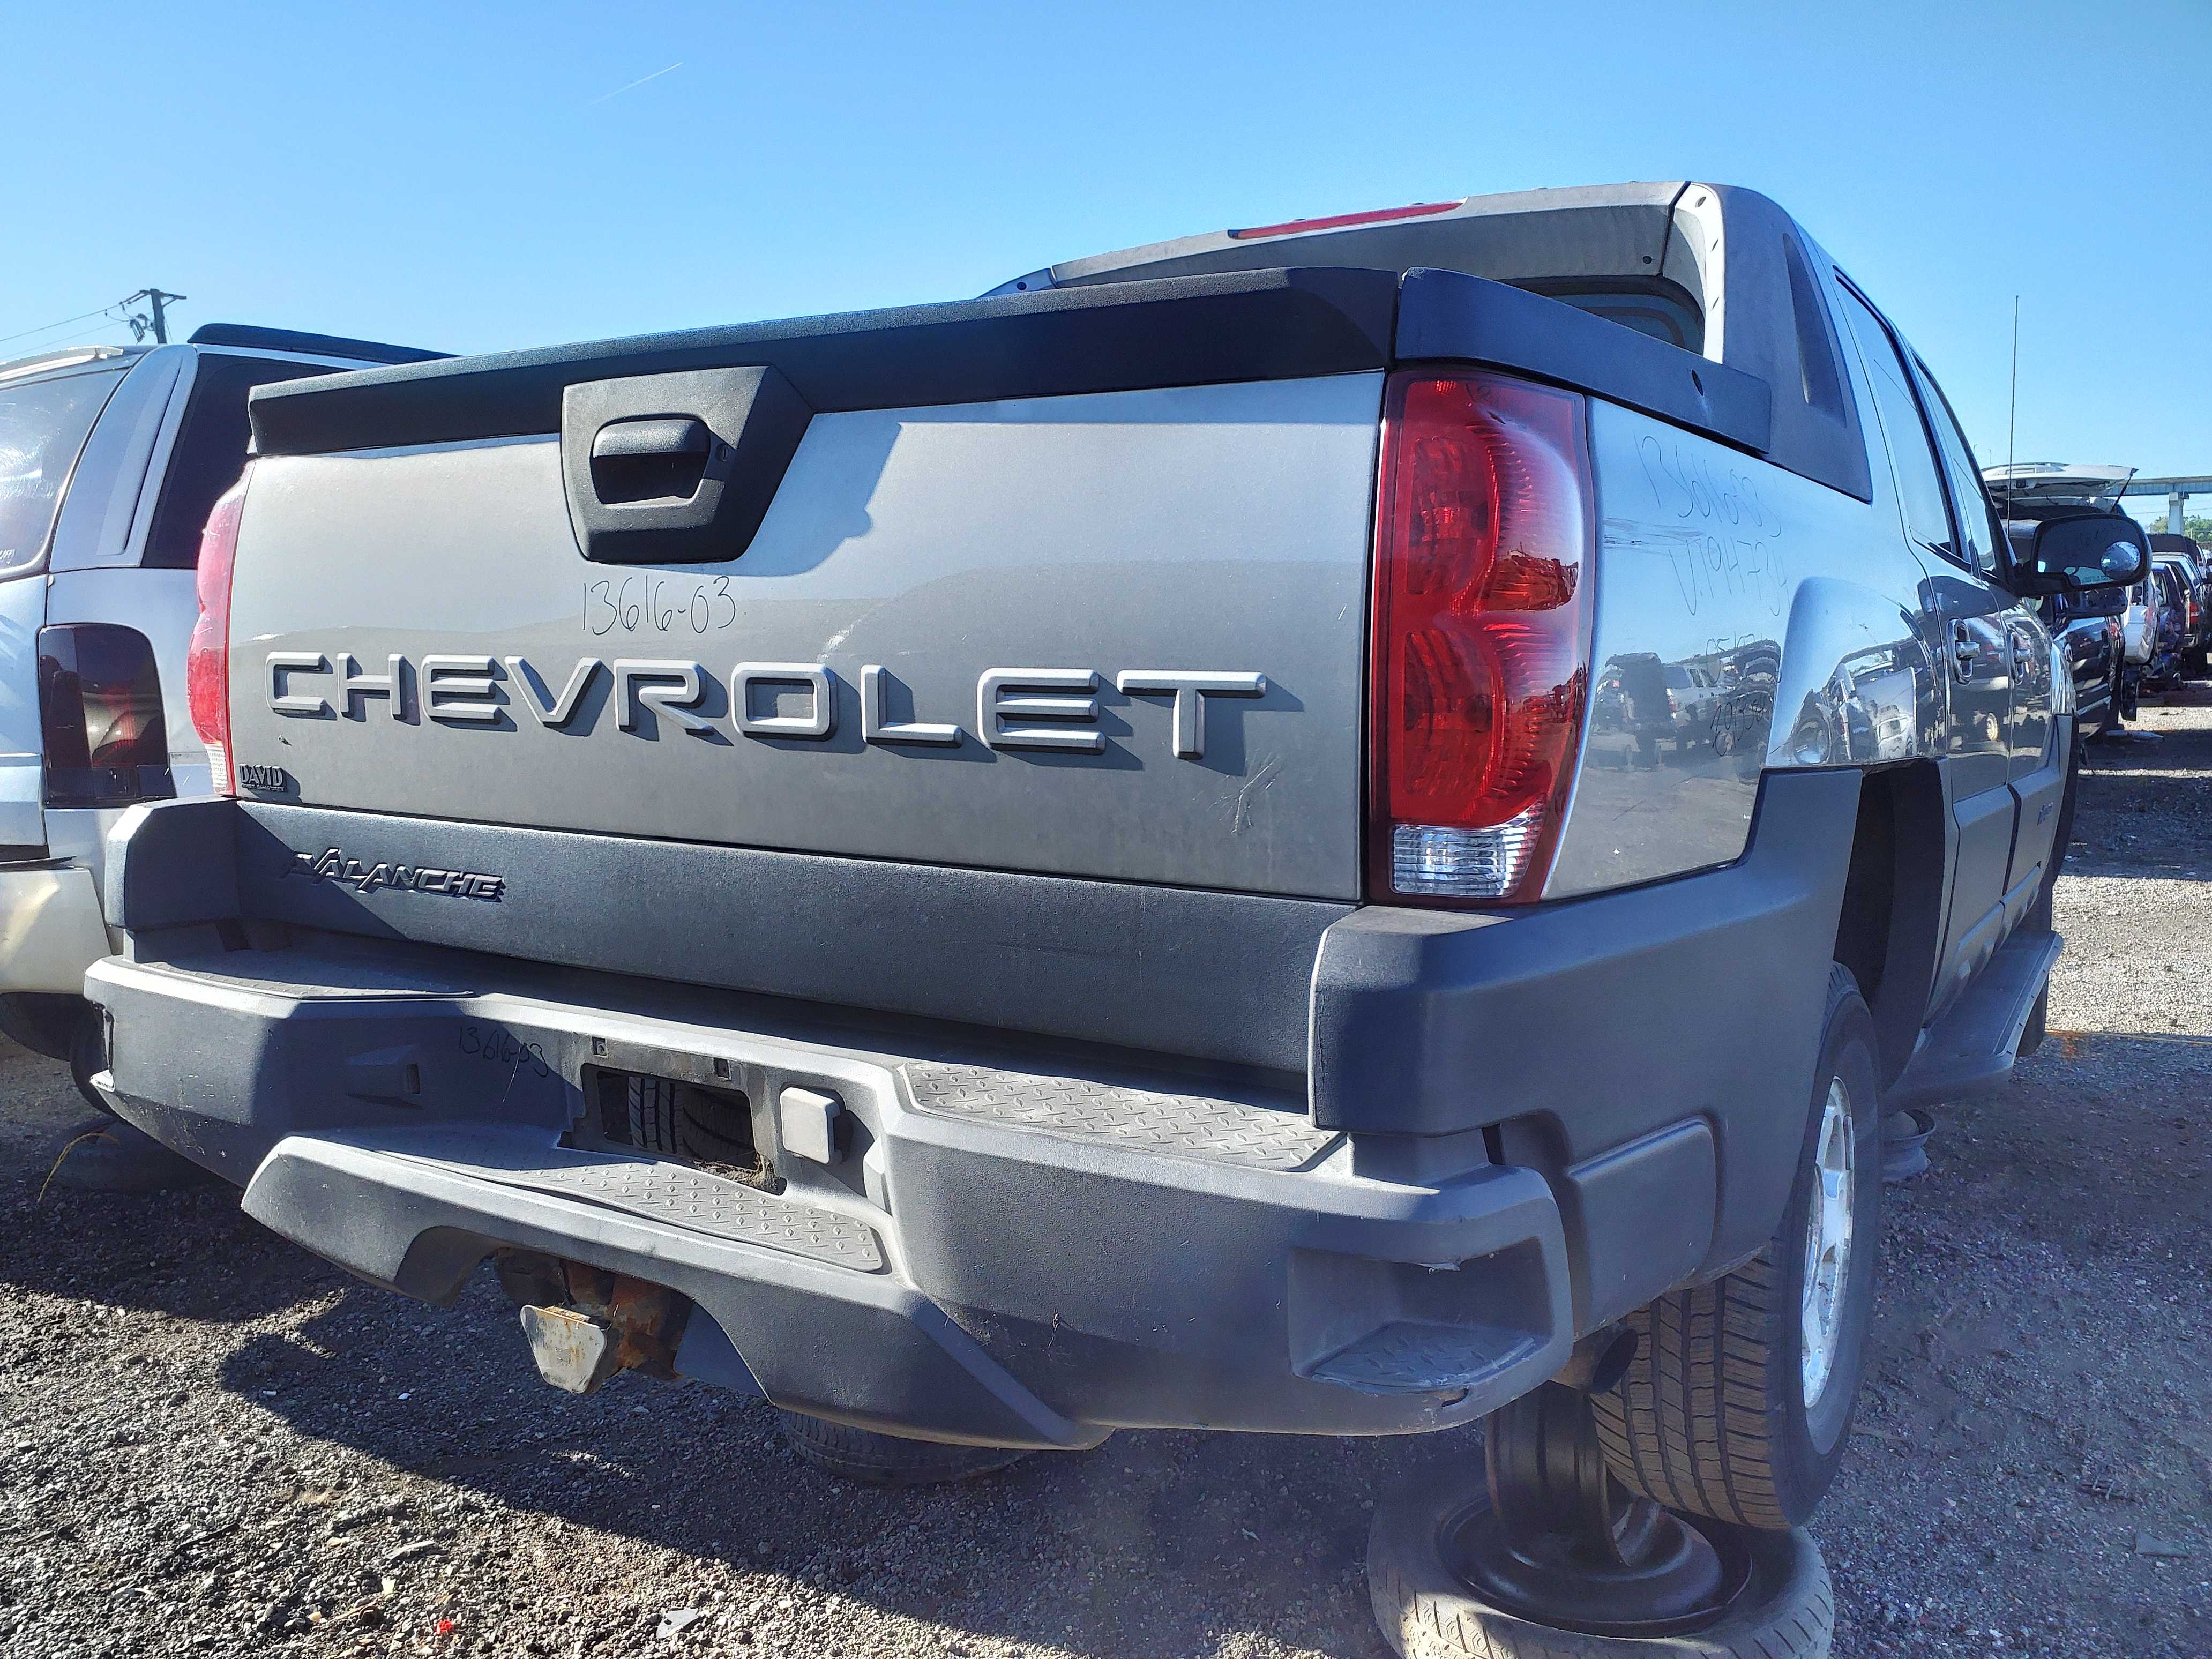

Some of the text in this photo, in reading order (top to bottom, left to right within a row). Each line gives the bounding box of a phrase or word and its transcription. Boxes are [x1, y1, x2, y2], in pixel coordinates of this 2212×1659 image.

[582, 574, 736, 635] 13616-03
[265, 651, 1267, 759] CHEVROLET
[238, 763, 283, 787] DAVID
[282, 848, 506, 903] AVALANCHE
[458, 1026, 550, 1078] 13616-03
